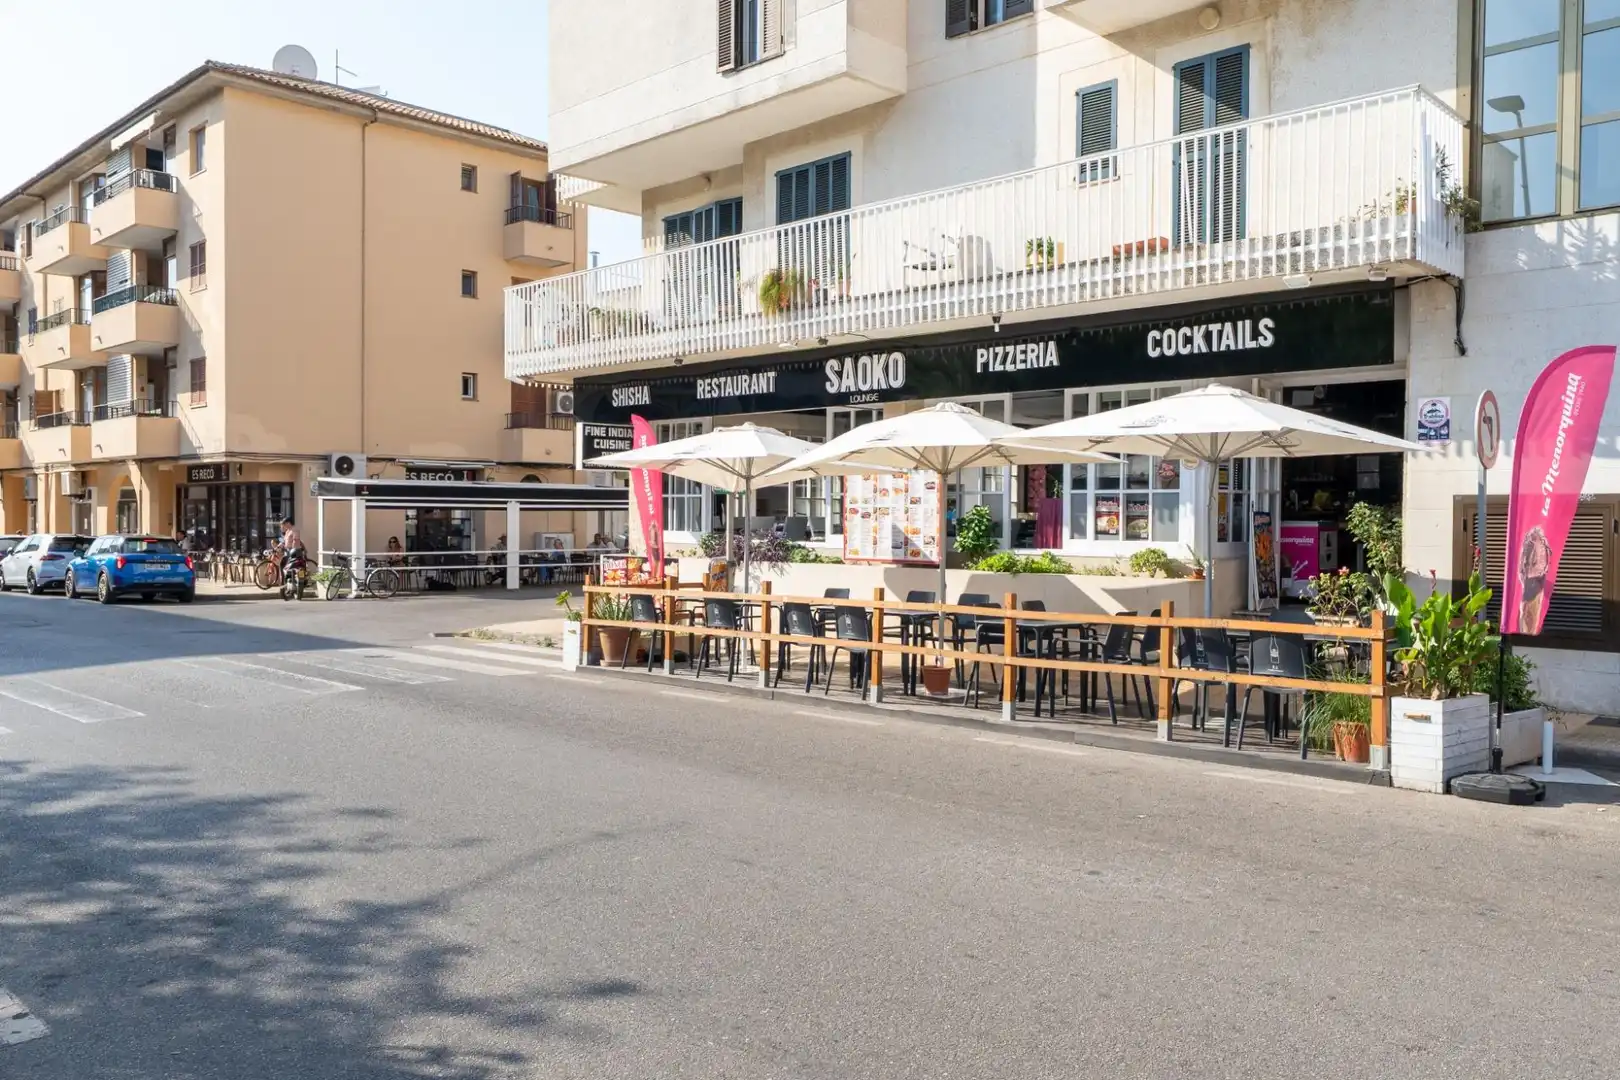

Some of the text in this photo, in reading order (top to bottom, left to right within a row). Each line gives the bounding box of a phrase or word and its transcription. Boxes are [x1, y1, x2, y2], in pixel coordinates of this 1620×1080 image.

[1147, 318, 1275, 358] COCKTAILS
[976, 341, 1060, 373] PIZZERIA
[825, 352, 906, 393] SAOKO
[612, 385, 650, 407] SHISHA
[697, 372, 776, 399] RESTAURANT
[850, 393, 879, 403] LOUNGE
[585, 426, 633, 438] FINE INDIA
[593, 438, 631, 450] CUISINE
[1541, 372, 1582, 493] Menorquina
[191, 469, 199, 480] ES
